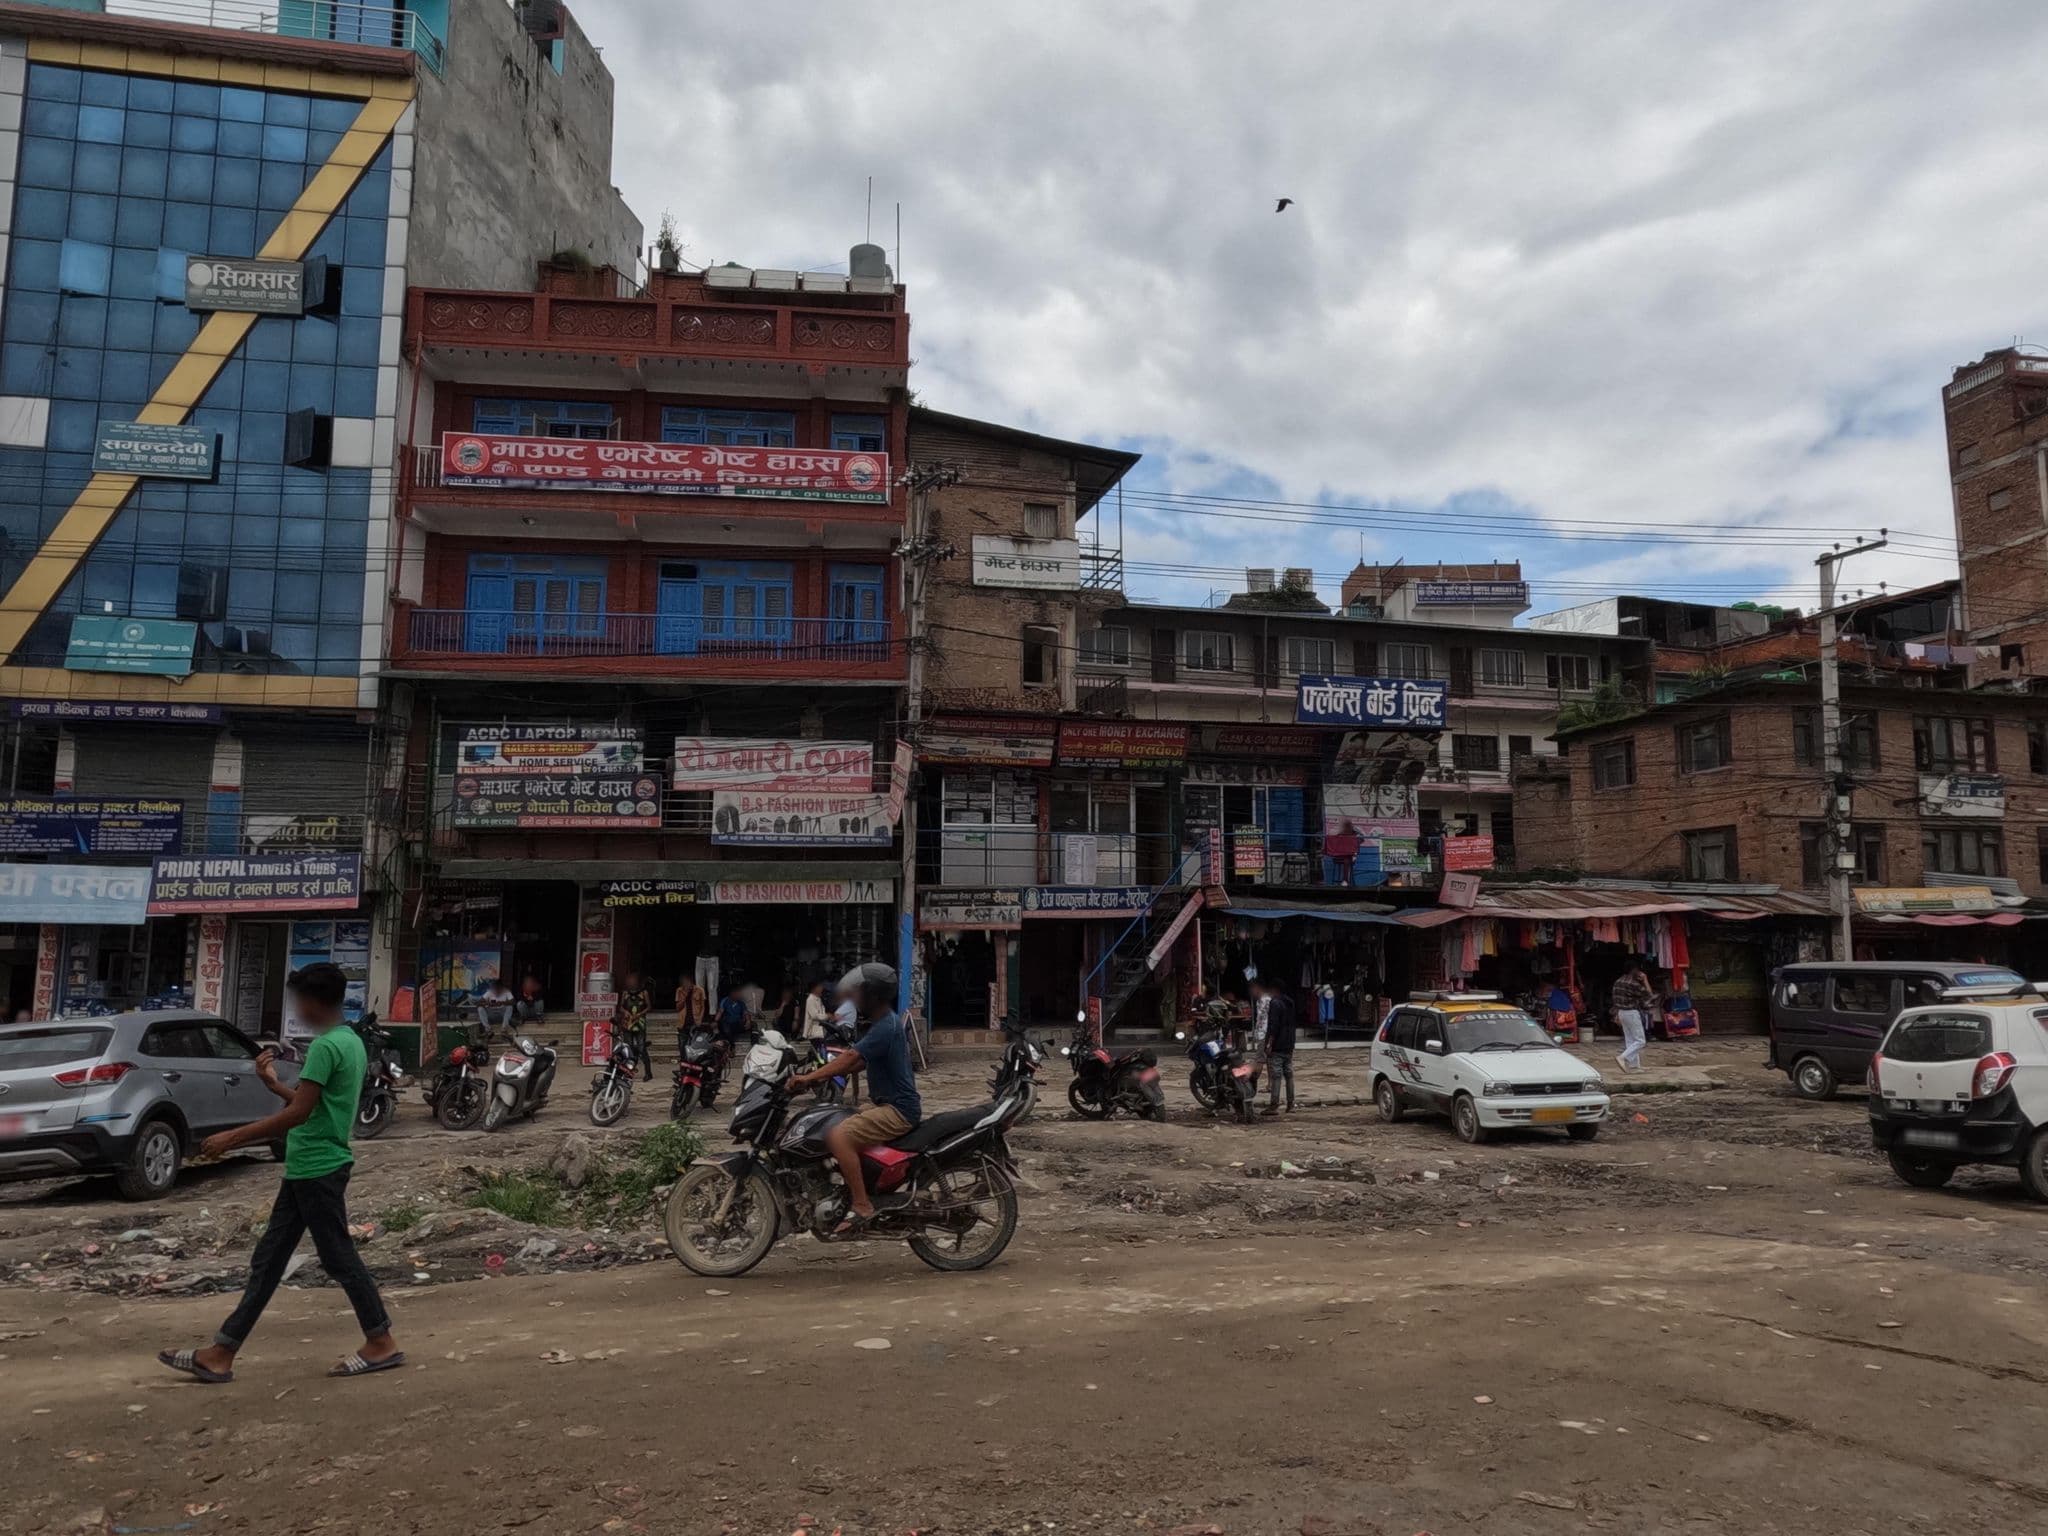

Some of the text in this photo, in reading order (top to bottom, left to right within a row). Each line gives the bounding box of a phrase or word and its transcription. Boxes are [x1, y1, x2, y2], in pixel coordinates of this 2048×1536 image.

[213, 264, 299, 291] सिमसार
[492, 441, 841, 471] माउण्ट एभरेष्ट गेष्ट हाउस
[523, 464, 810, 486] एण्ड नेपाली किचेन
[1366, 681, 1398, 717] बोर्ड
[1402, 681, 1444, 721] प्रिन्ट
[466, 727, 638, 741] ACDC LAPTOP REPAIR
[1063, 726, 1186, 739] ONLY ONE MONEY EXCHANGE
[503, 744, 534, 754] SALES
[549, 744, 586, 754] REPAIR
[519, 758, 598, 767] HOME SERVICE
[480, 780, 521, 796] माउण्ट
[570, 777, 595, 796] गेष्ट
[598, 780, 632, 797] हाउस
[56, 802, 75, 814] हल
[79, 803, 99, 814] एण्ड
[102, 804, 135, 815] डाक्टर
[495, 800, 613, 814] एण्ड नेपाली किचेन
[767, 798, 825, 813] FASHION
[828, 798, 866, 813] WEAR
[1235, 828, 1264, 837] MONEY
[157, 861, 200, 878] PRIDE
[204, 860, 246, 877] NEPAL
[248, 863, 291, 876] TRAVELS
[293, 862, 301, 875] &
[304, 862, 337, 876] TOURS
[192, 879, 231, 897] नेपाल
[276, 882, 299, 895] एण्ड
[610, 880, 653, 893] ACDC
[720, 883, 844, 901] B.S FASHION WEAR
[603, 892, 695, 907] होलसेल मित्र
